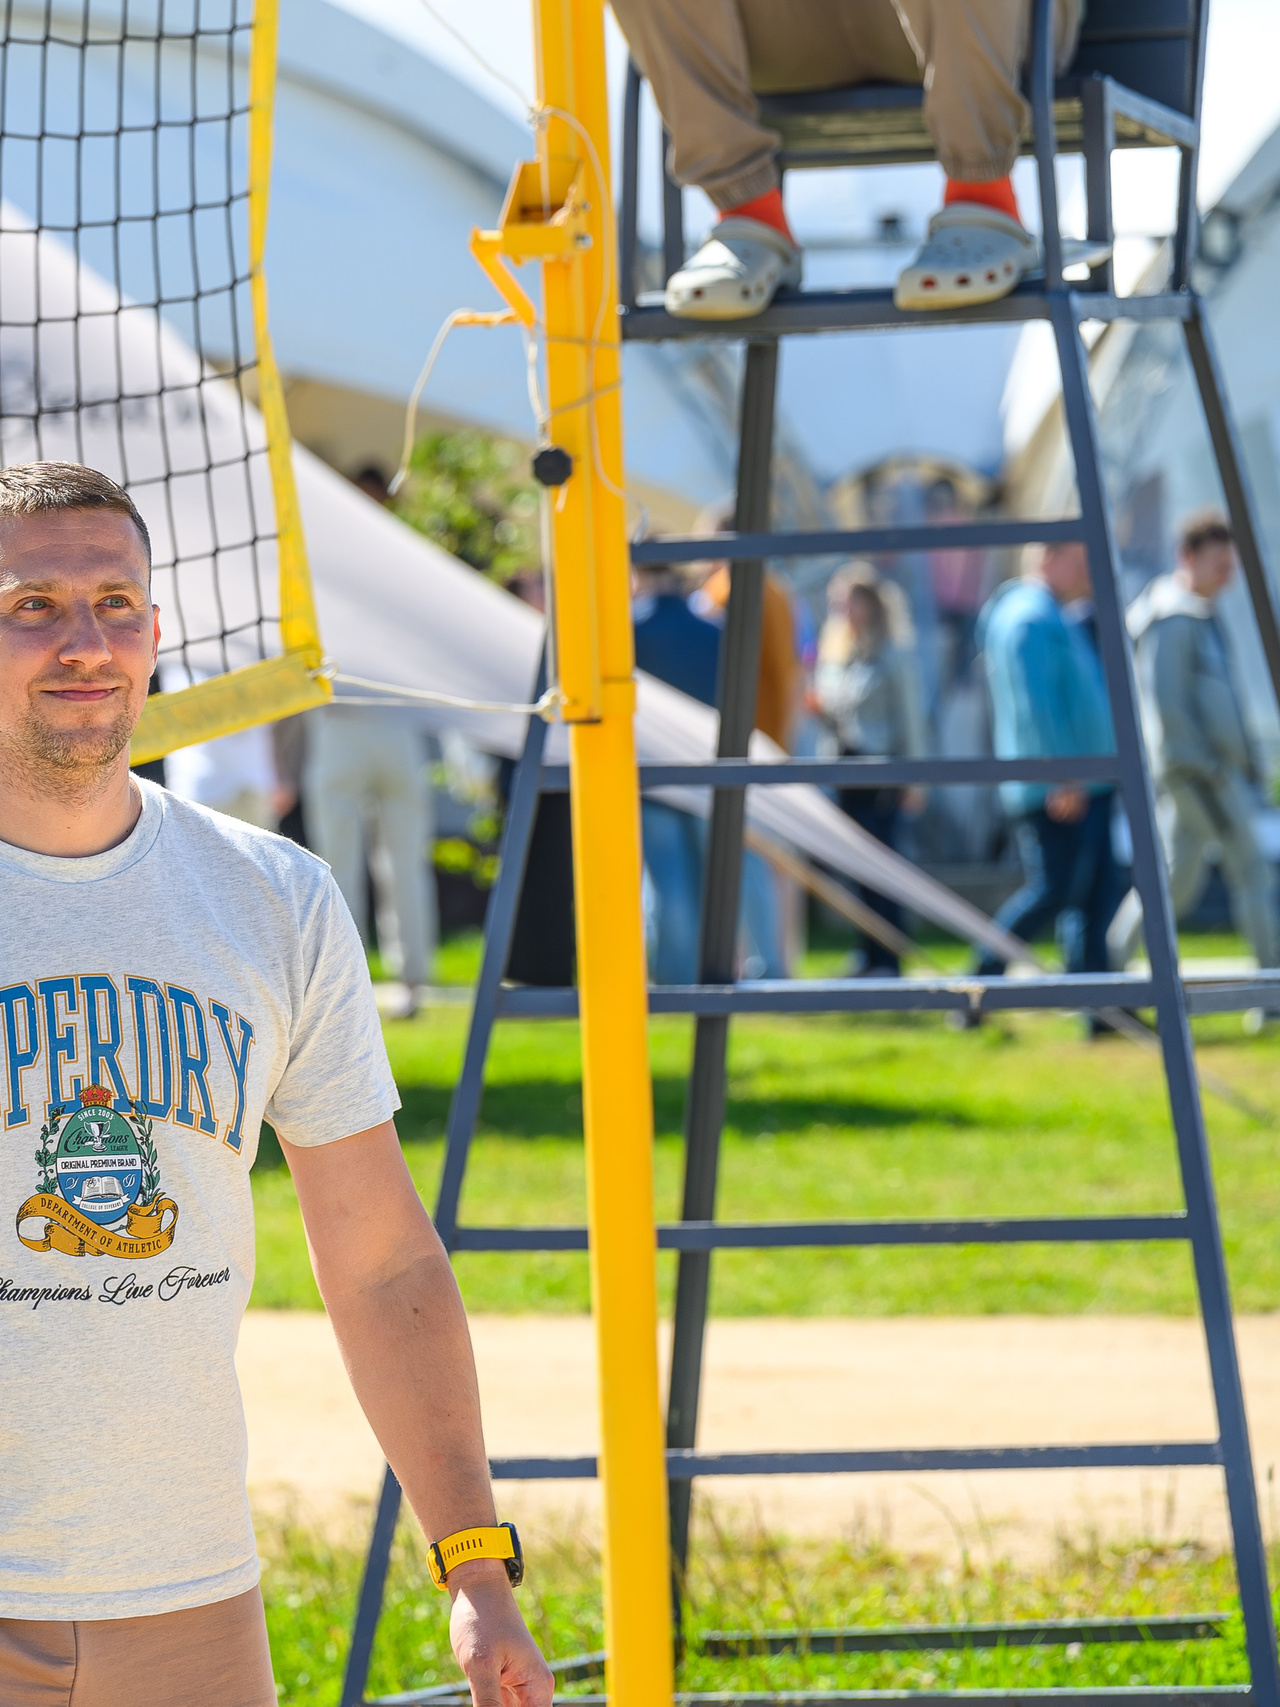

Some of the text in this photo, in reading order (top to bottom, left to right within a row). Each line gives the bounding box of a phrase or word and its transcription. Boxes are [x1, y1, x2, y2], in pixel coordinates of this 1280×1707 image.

[77, 1109, 114, 1121] SINCE 2003
[61, 1158, 137, 1169] ORIGINAL PREMIUM BRAND
[40, 1197, 162, 1254] DEPARTMENT OF ATHLETIC
[98, 1272, 153, 1306] Live
[158, 1265, 231, 1302] Forever
